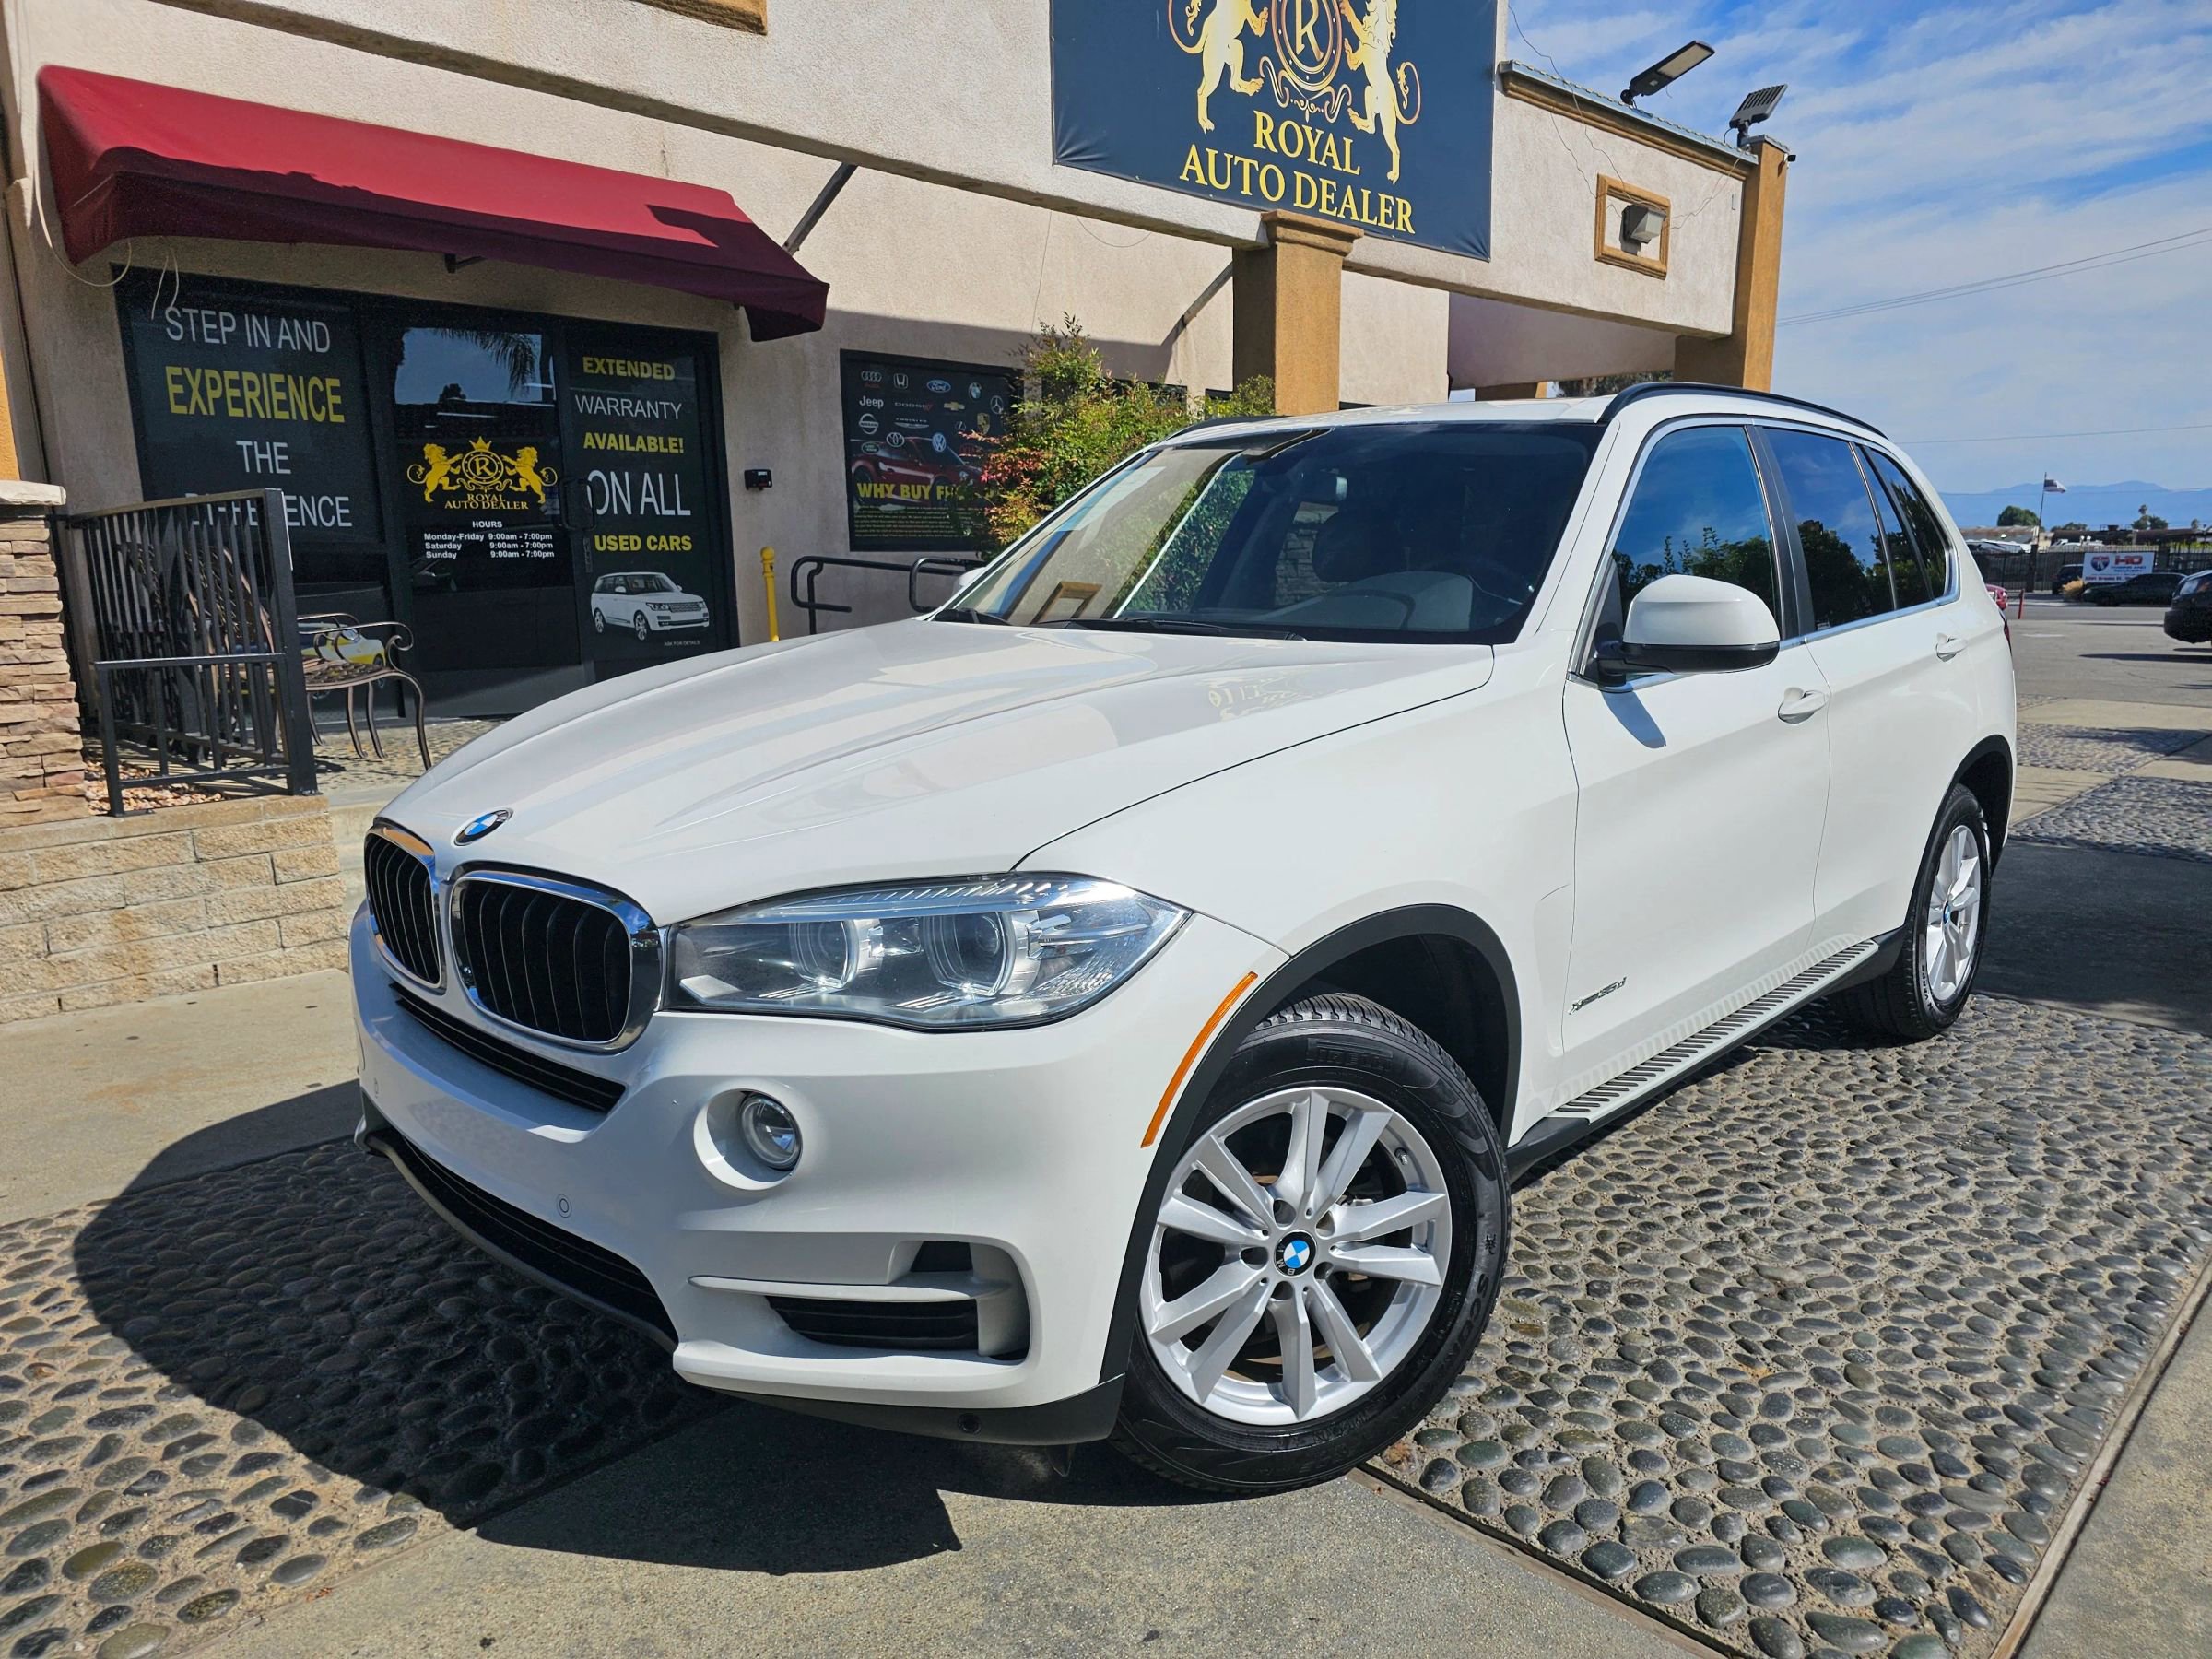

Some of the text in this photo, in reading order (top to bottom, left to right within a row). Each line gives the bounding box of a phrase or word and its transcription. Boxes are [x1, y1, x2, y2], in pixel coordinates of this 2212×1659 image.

[1253, 110, 1360, 176] ROYAL
[1179, 143, 1416, 234] AUTO DEALER
[164, 307, 330, 353] STEP IN AND
[582, 356, 675, 381] EXTENDED
[165, 366, 345, 423] EXPERIENCE
[859, 395, 884, 409] Jeep
[575, 394, 682, 420] WARRANTY
[583, 432, 684, 453] AVAILABLE!
[236, 441, 291, 475] THE
[467, 493, 506, 502] ROYAL
[587, 469, 691, 516] ON ALL
[857, 482, 896, 499] WHY
[900, 484, 932, 500] BUY
[444, 500, 529, 510] AUTO DEALER
[424, 533, 484, 542] Monday-Friday
[524, 533, 552, 542] 7:00pm
[425, 542, 462, 550] Saturday
[524, 542, 553, 550] 7:00pm
[594, 535, 692, 551] USED CARS
[426, 551, 457, 559] Sunday
[526, 550, 555, 559] 7:00pm
